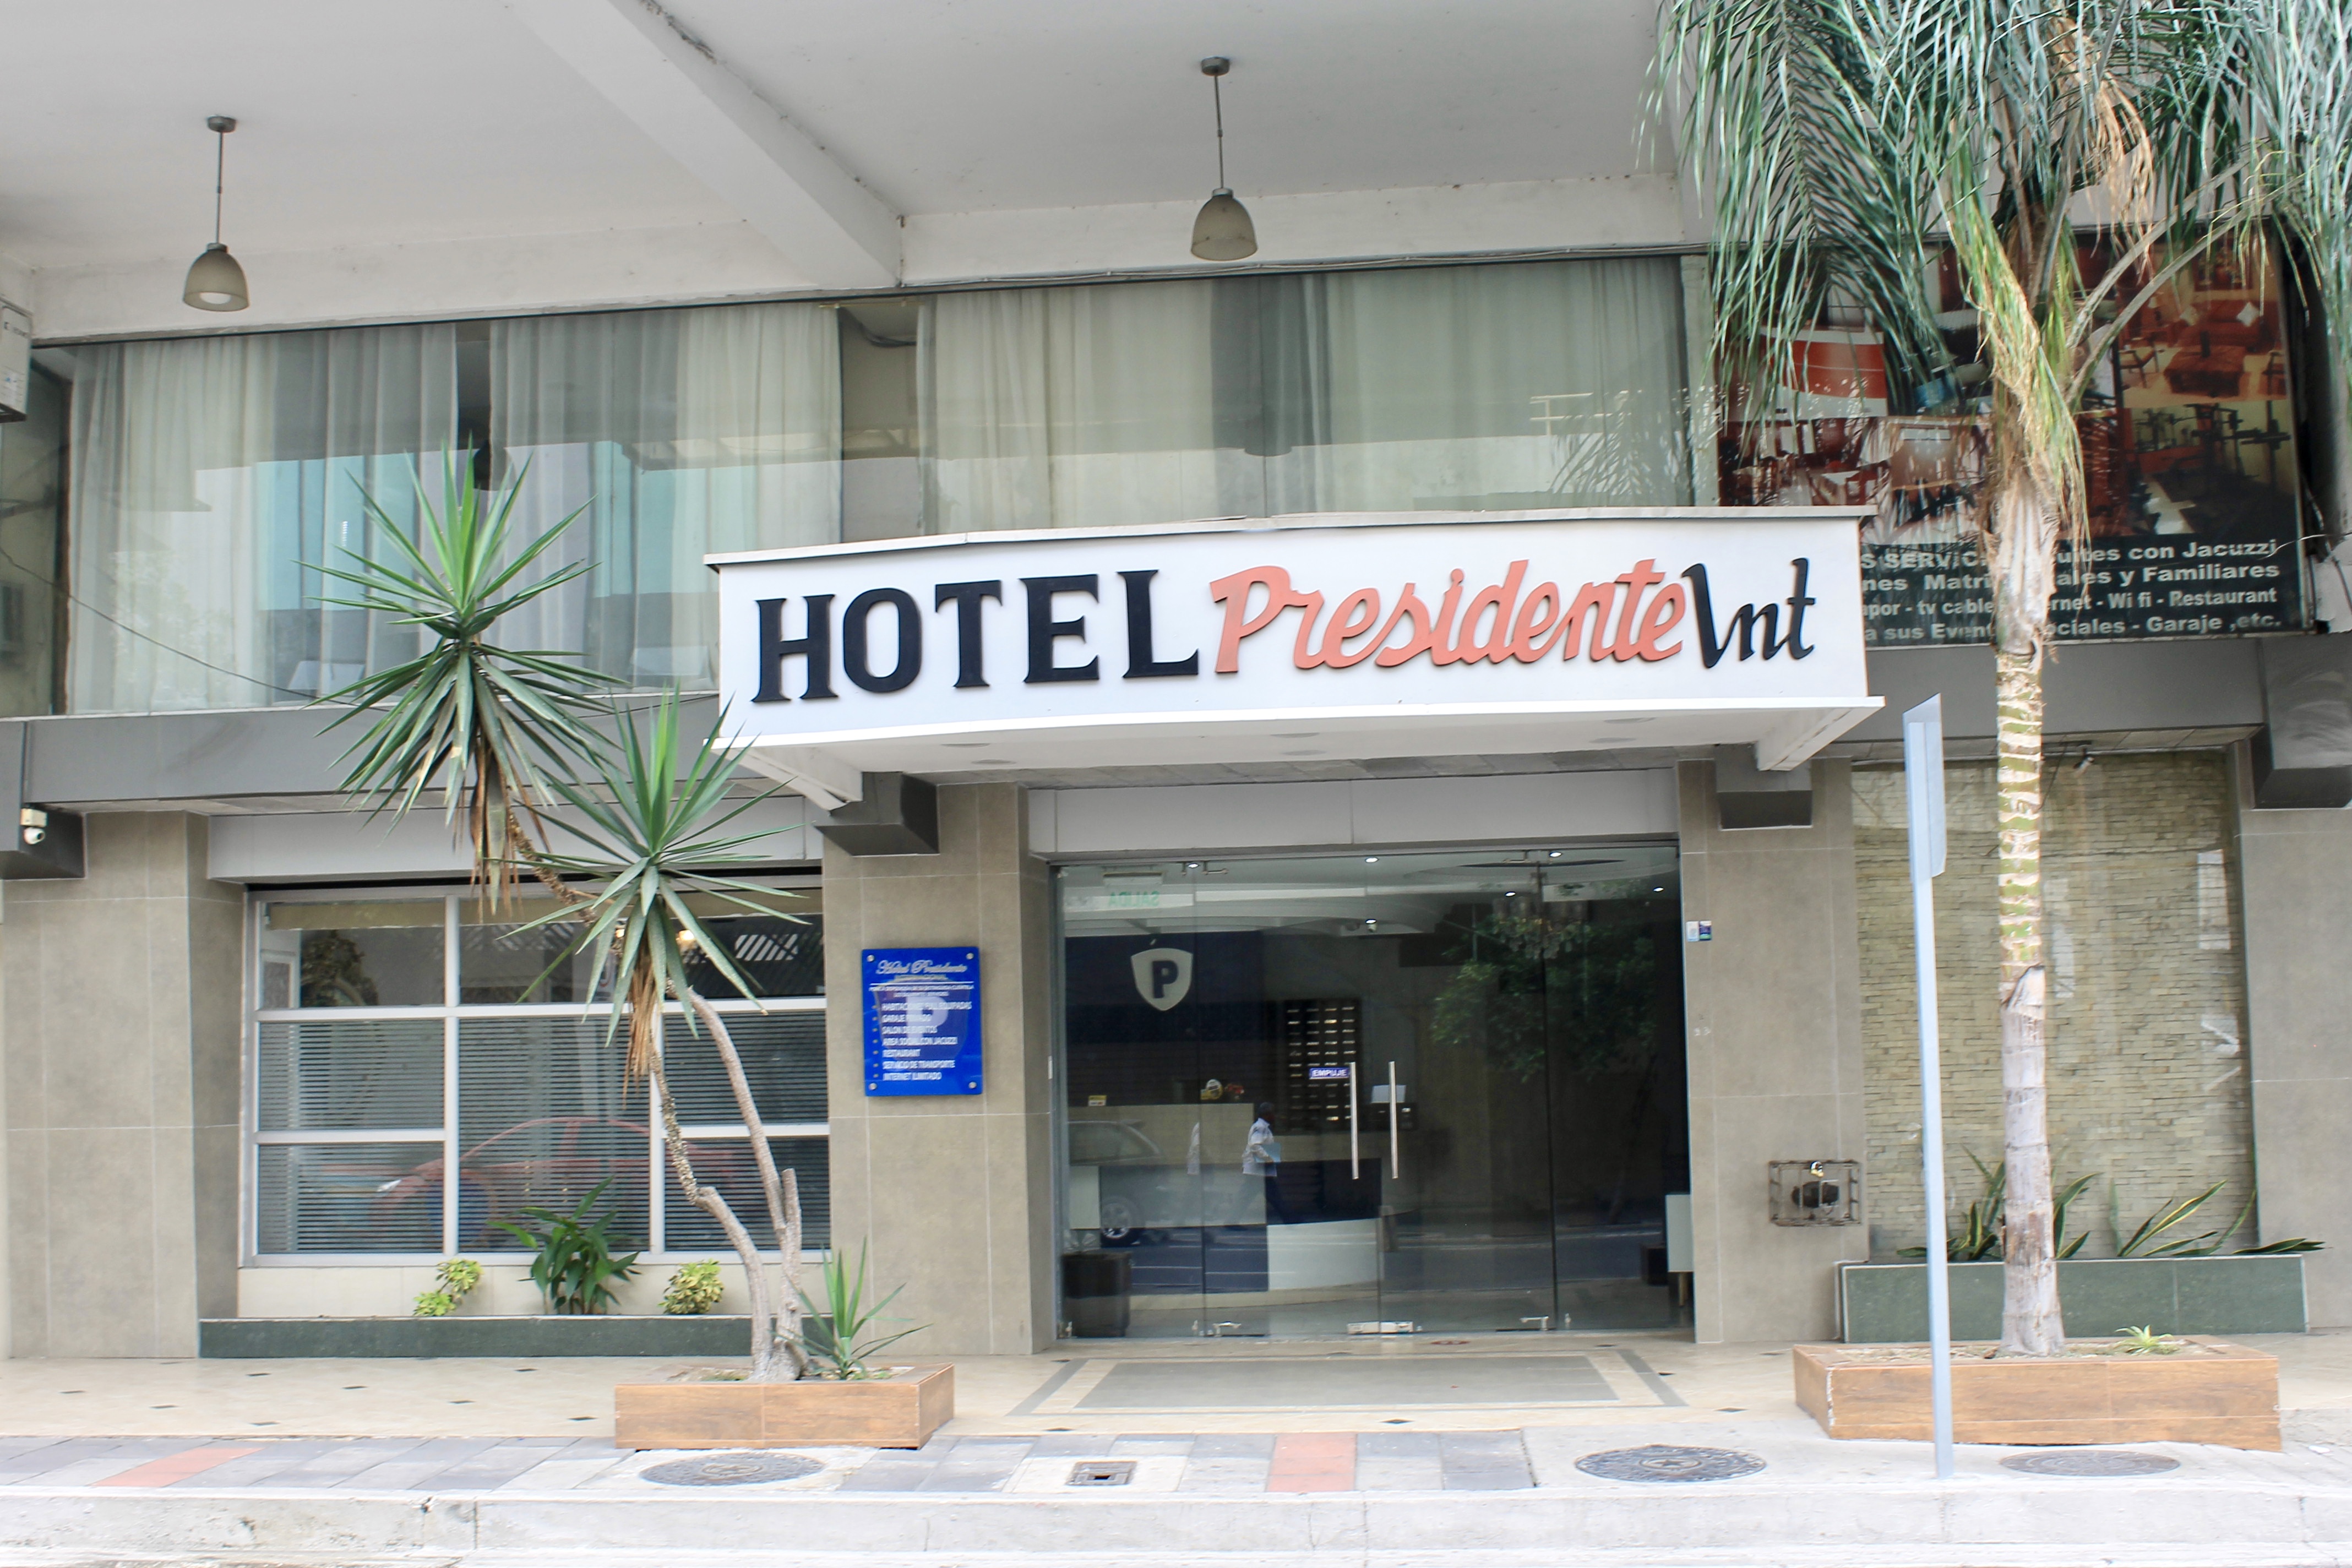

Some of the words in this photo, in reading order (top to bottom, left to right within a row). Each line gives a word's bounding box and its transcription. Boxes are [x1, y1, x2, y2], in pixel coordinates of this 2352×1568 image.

[1861, 553, 1877, 569] S
[1884, 551, 1987, 570] SERVIC
[2128, 546, 2175, 560] con
[2182, 539, 2277, 558] Jacuzzi
[1863, 578, 1909, 592] nes
[2120, 570, 2135, 587] y
[2142, 563, 2280, 582] Familiares
[1917, 600, 1936, 615] tv
[1942, 598, 1994, 614] cable
[2048, 594, 2092, 611] rnet
[2107, 592, 2133, 609] Wi
[2138, 591, 2153, 607] fi
[2168, 587, 2277, 606] Restaurant
[752, 570, 1198, 703] HOTEL
[1211, 560, 1685, 672] Presidente
[1883, 627, 1925, 641] sus
[2045, 618, 2126, 635] ociales
[2147, 614, 2223, 634] Garaje
[1152, 960, 1178, 998] P
[1311, 1069, 1347, 1077] EMPUJE
